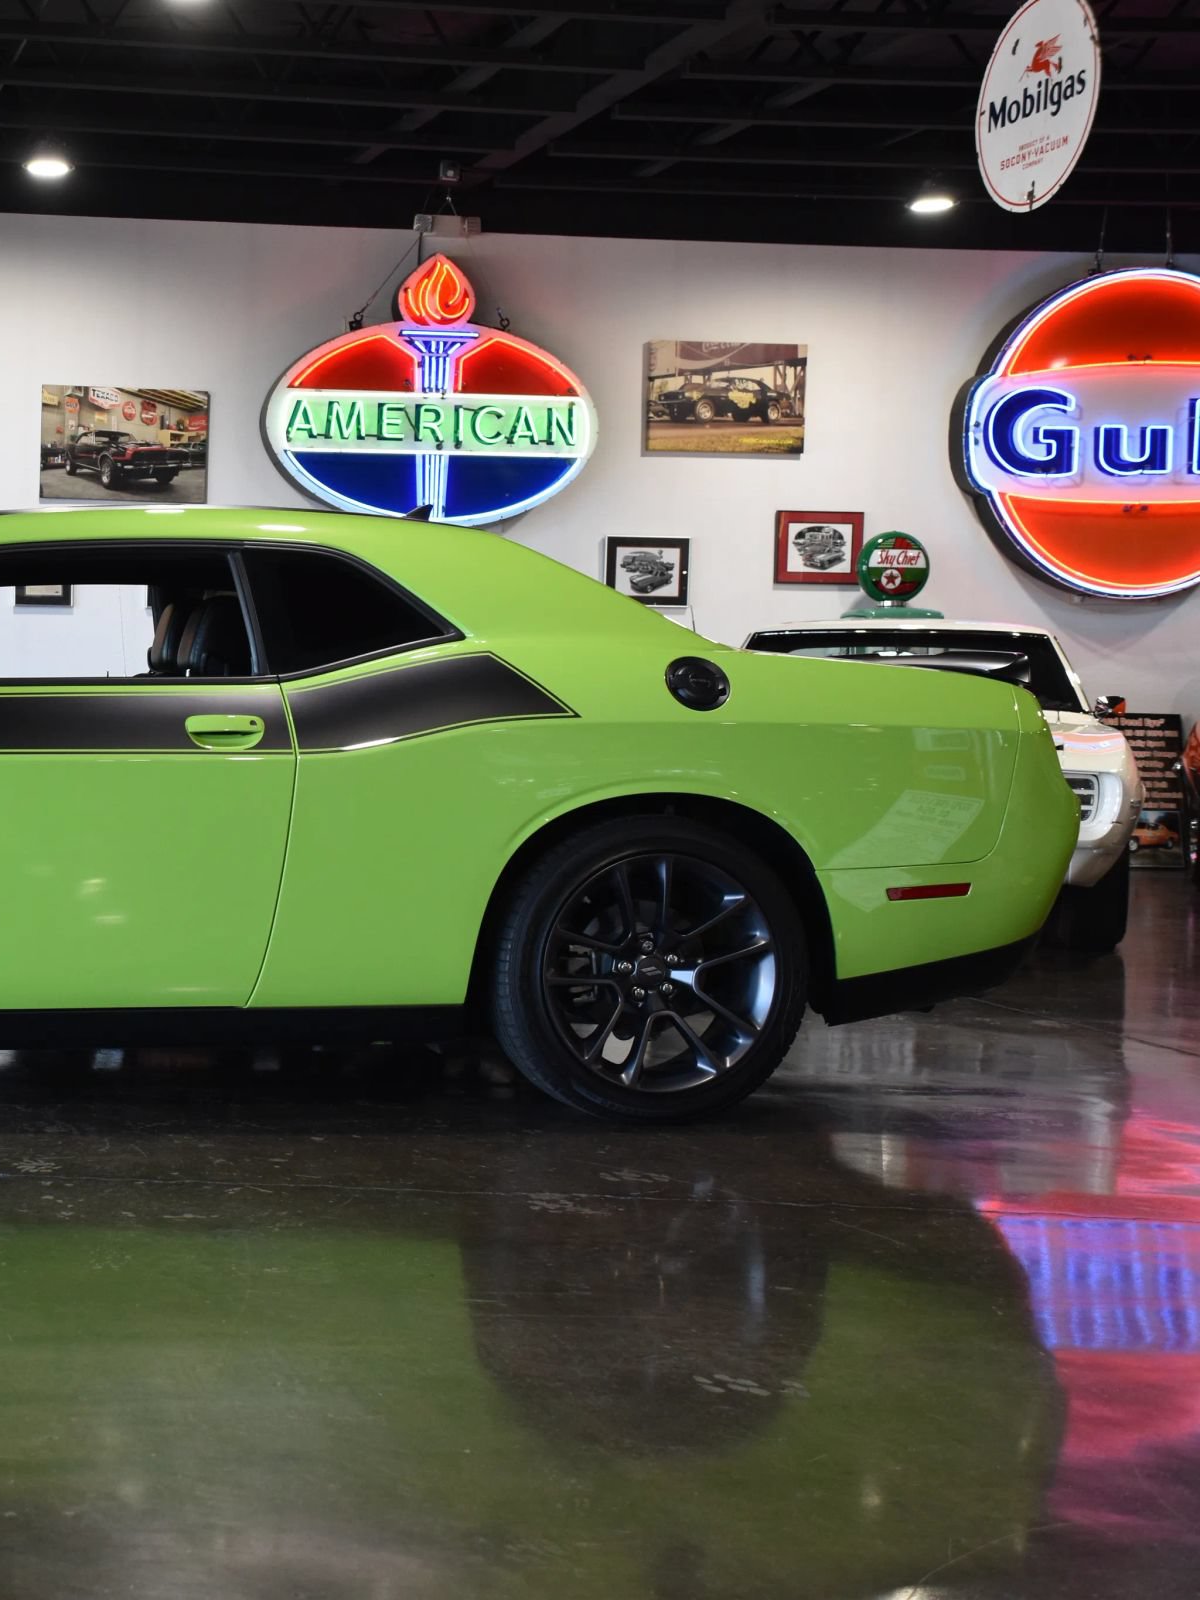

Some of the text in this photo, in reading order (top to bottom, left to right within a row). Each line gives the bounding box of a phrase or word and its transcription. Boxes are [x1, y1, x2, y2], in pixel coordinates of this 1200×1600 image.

[988, 69, 1087, 133] Mobilgas
[1000, 136, 1069, 171] SOCONY-VACUUM
[287, 399, 576, 446] AMERICAN
[877, 549, 921, 567] Sky Chief
